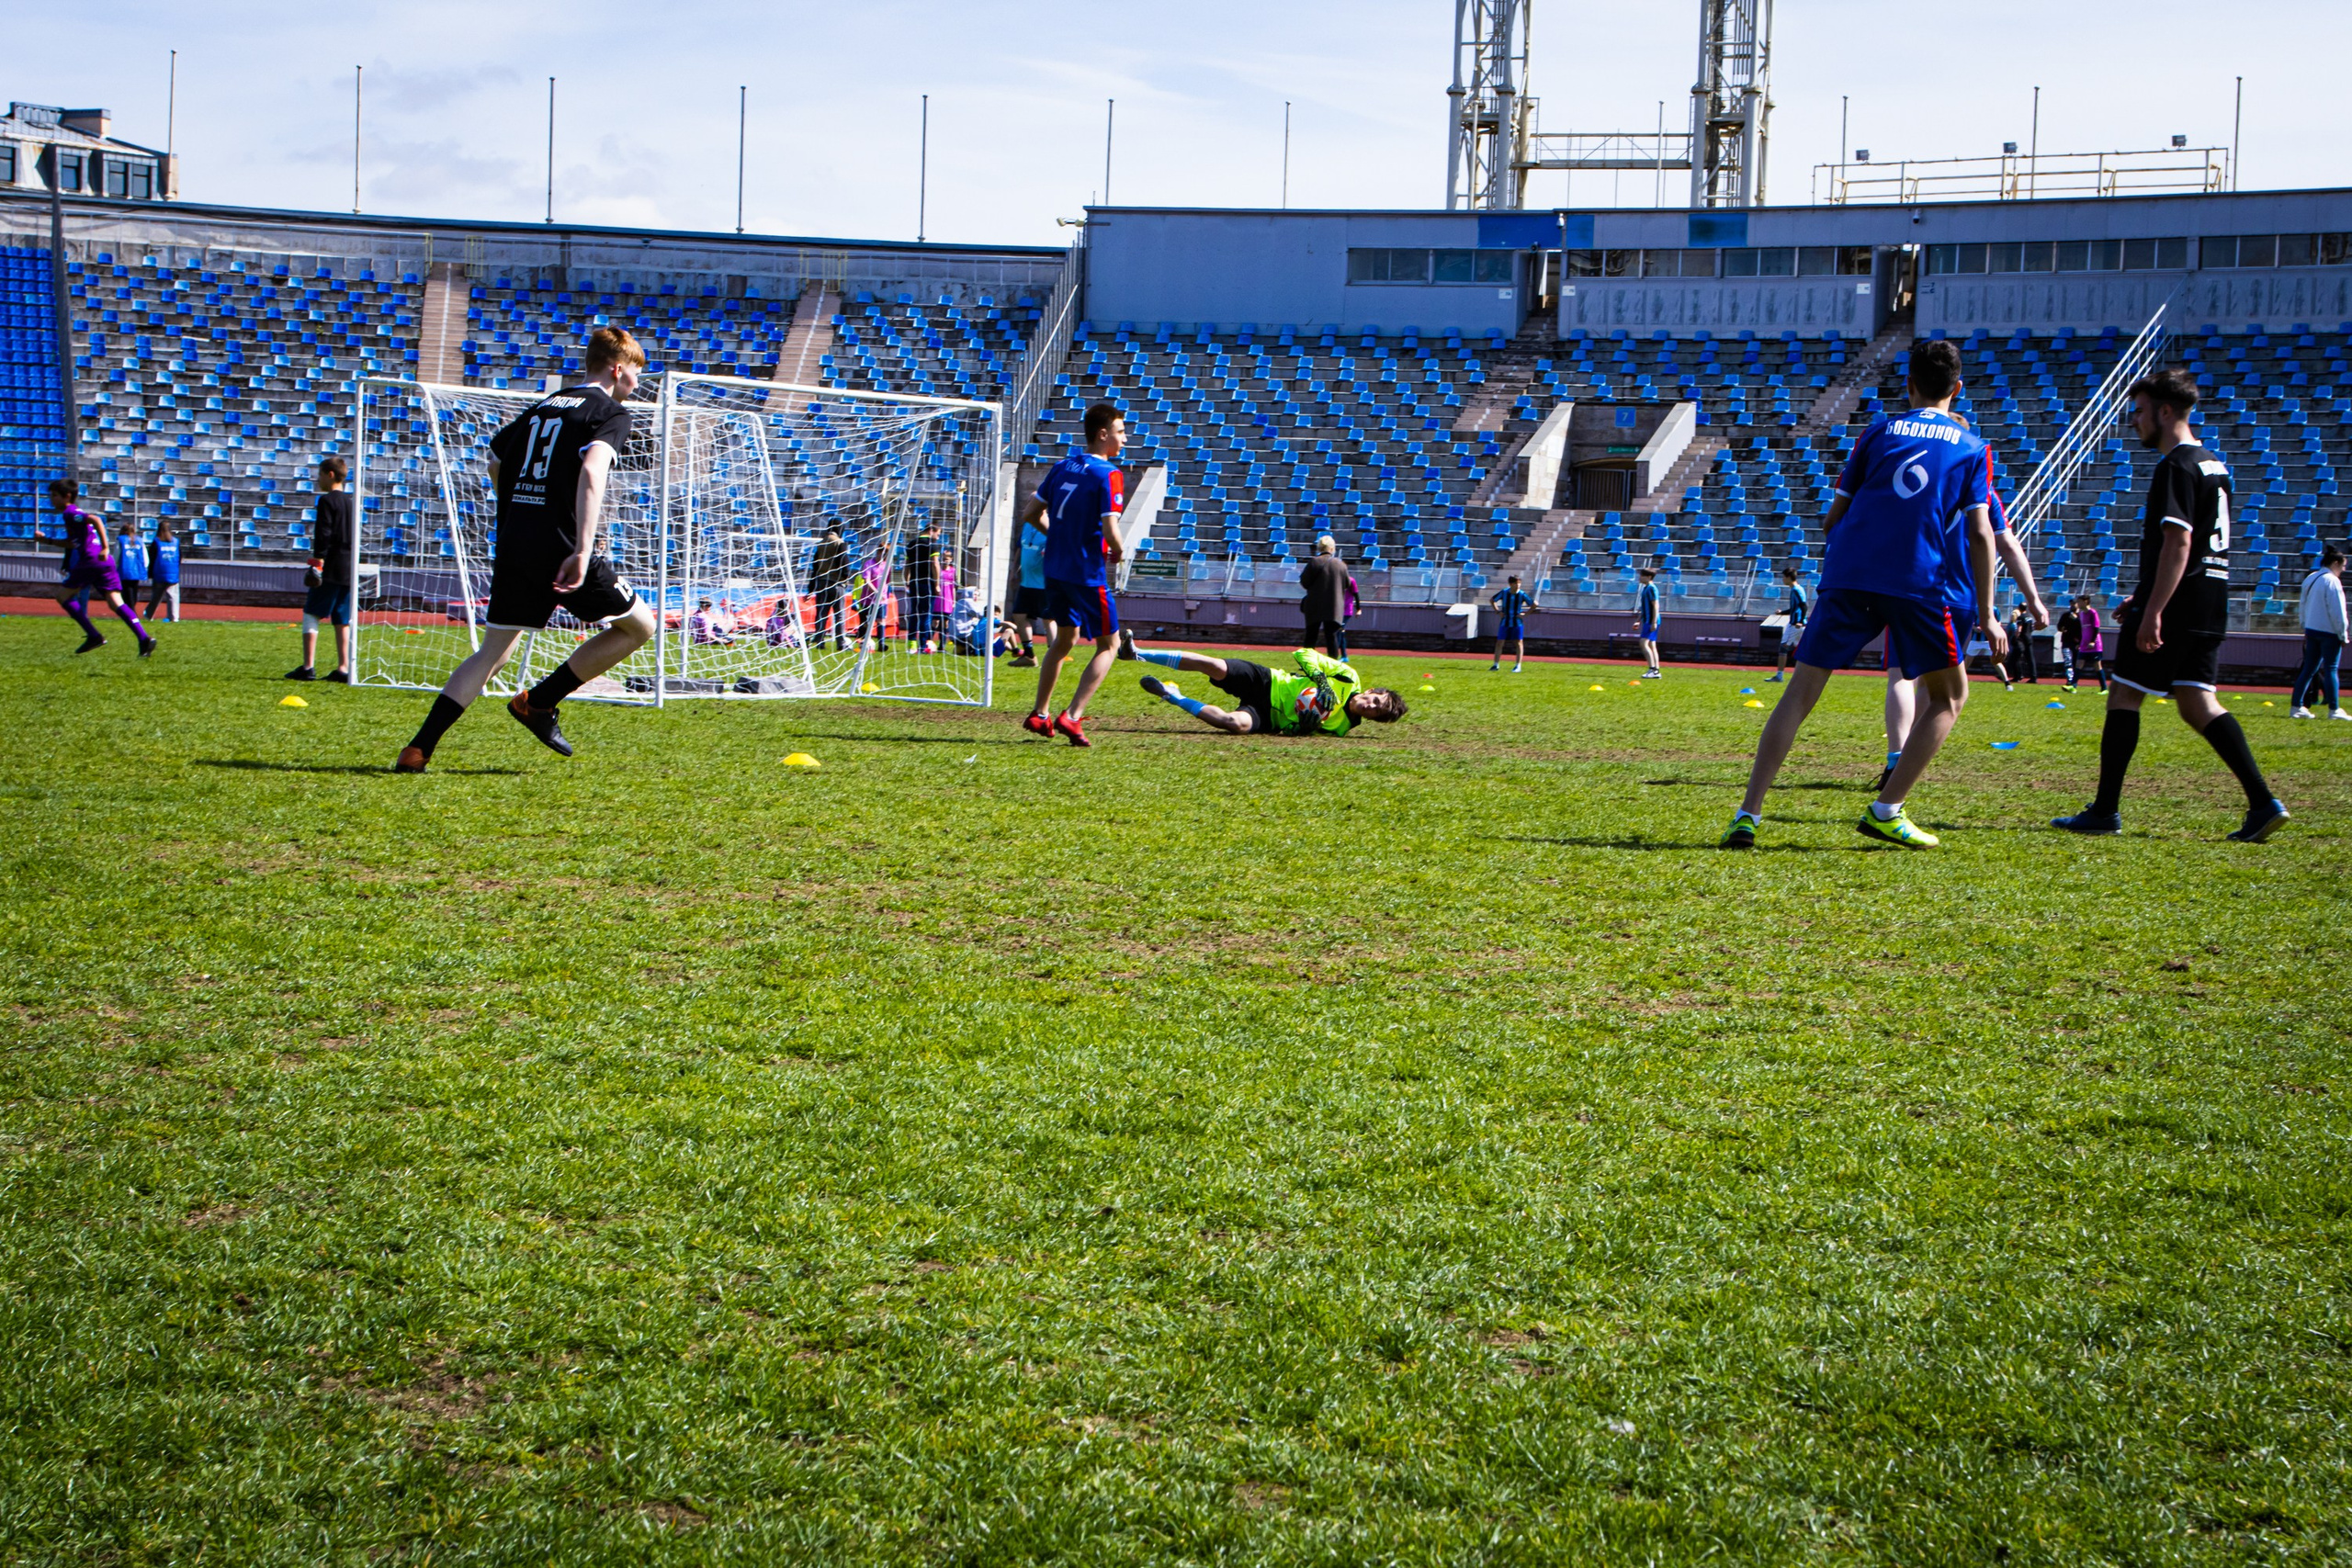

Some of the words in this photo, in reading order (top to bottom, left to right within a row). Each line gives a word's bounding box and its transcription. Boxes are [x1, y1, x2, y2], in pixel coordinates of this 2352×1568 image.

[1622, 412, 1629, 421] 7
[1885, 420, 1961, 445] БОБОХОНОВ
[519, 414, 563, 480] 13
[1893, 450, 1928, 499] 6
[1057, 482, 1079, 519] 7
[614, 575, 634, 603] 13
